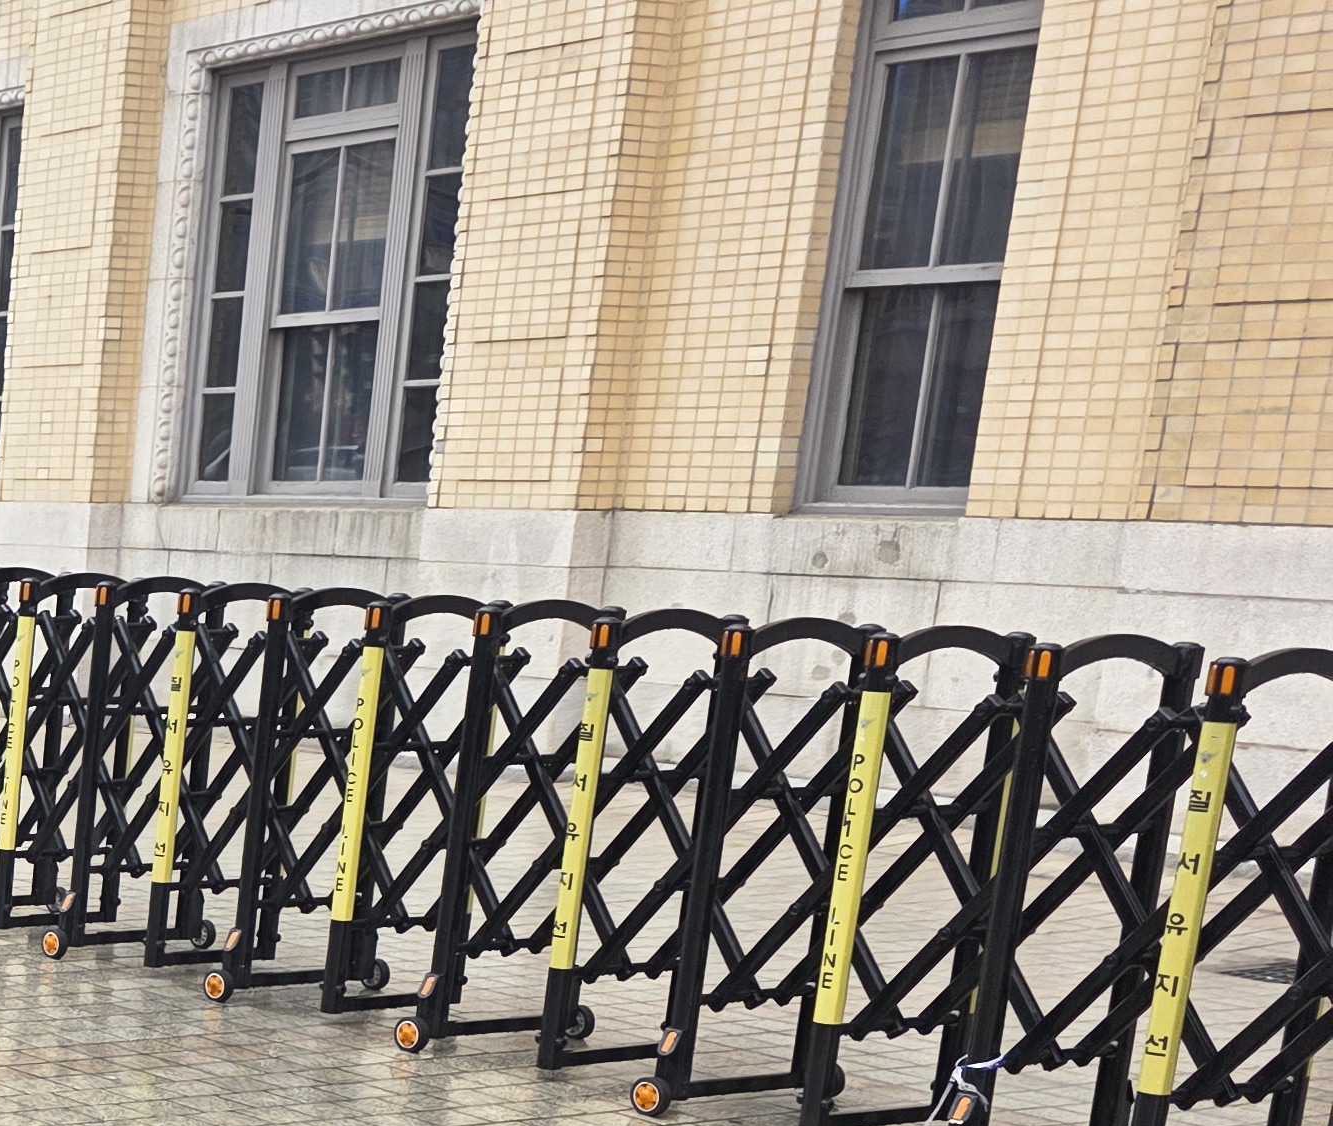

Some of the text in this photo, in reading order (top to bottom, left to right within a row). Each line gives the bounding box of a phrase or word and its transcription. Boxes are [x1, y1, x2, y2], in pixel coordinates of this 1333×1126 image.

[821, 753, 866, 989] POLICE LINE
[1145, 789, 1212, 1058] 질서유지선
